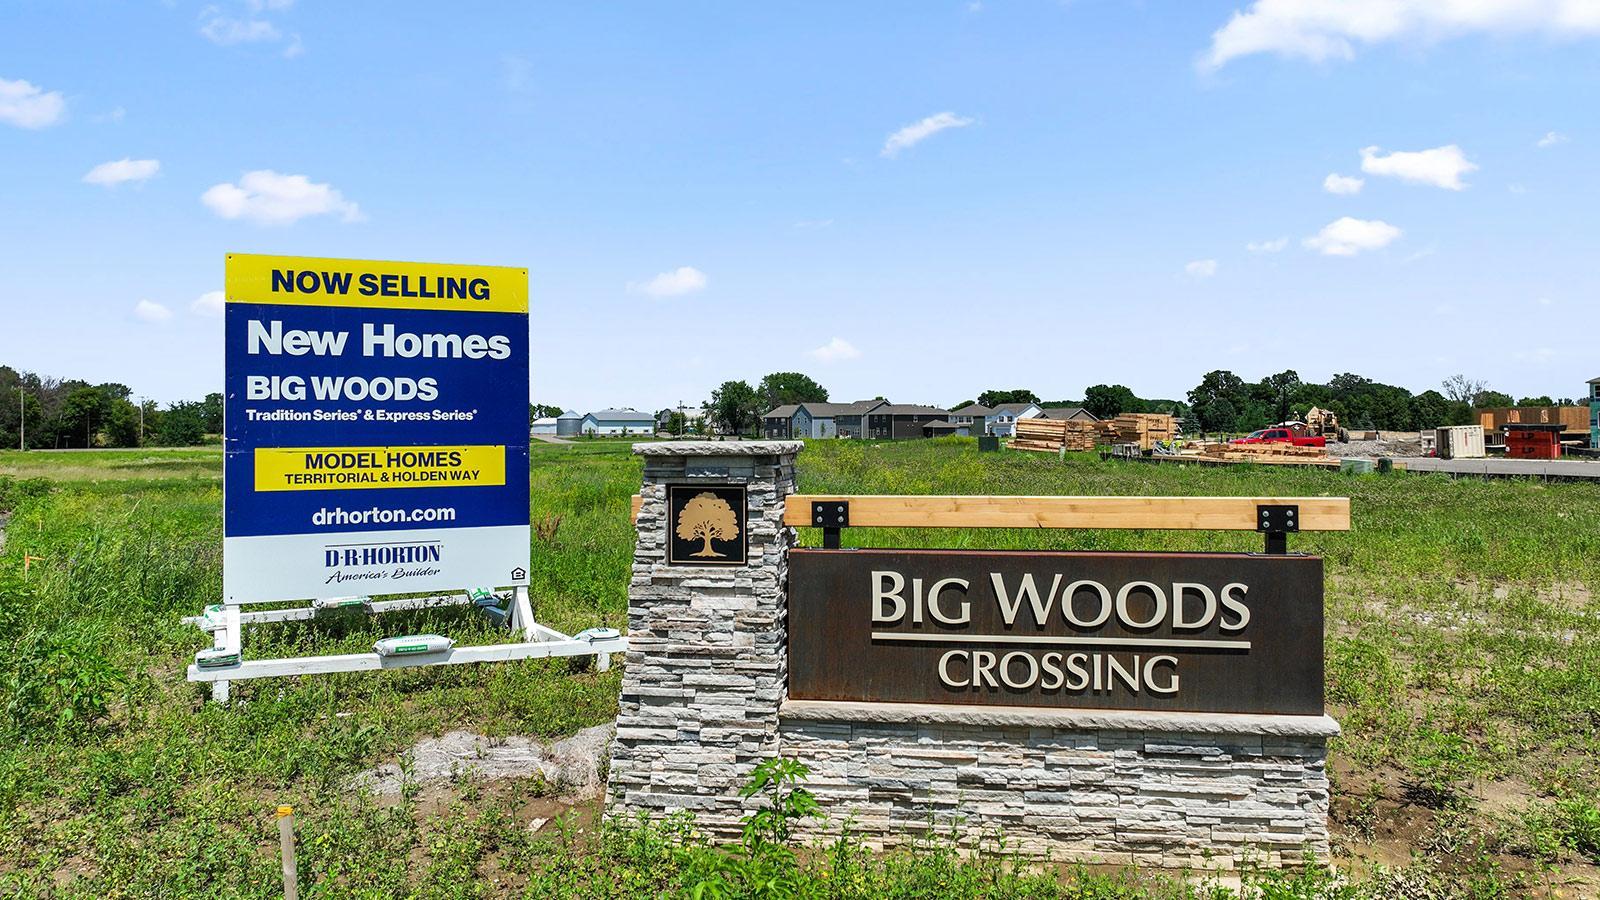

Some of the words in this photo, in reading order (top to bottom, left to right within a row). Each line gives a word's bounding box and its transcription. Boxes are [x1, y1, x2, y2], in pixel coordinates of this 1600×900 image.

[271, 269, 353, 295] NOW
[358, 274, 491, 300] SELLING
[247, 319, 349, 356] New
[362, 323, 511, 360] Homes
[246, 375, 306, 401] BIG
[310, 375, 439, 401] WOODS
[246, 409, 312, 421] Tradition
[363, 409, 375, 421] &
[376, 409, 431, 423] Express
[305, 452, 383, 470] MODEL
[386, 451, 462, 468] HOMES
[284, 472, 378, 485] TERRITORIAL
[380, 471, 390, 483] &
[392, 470, 450, 482] HOLDEN
[450, 469, 480, 481] WAY
[312, 506, 456, 526] drhorton.com
[325, 570, 389, 585] America's
[390, 566, 441, 580] Builder
[871, 570, 971, 625] BIG
[990, 572, 1252, 631] WOODS
[937, 650, 1180, 694] CROSSING
